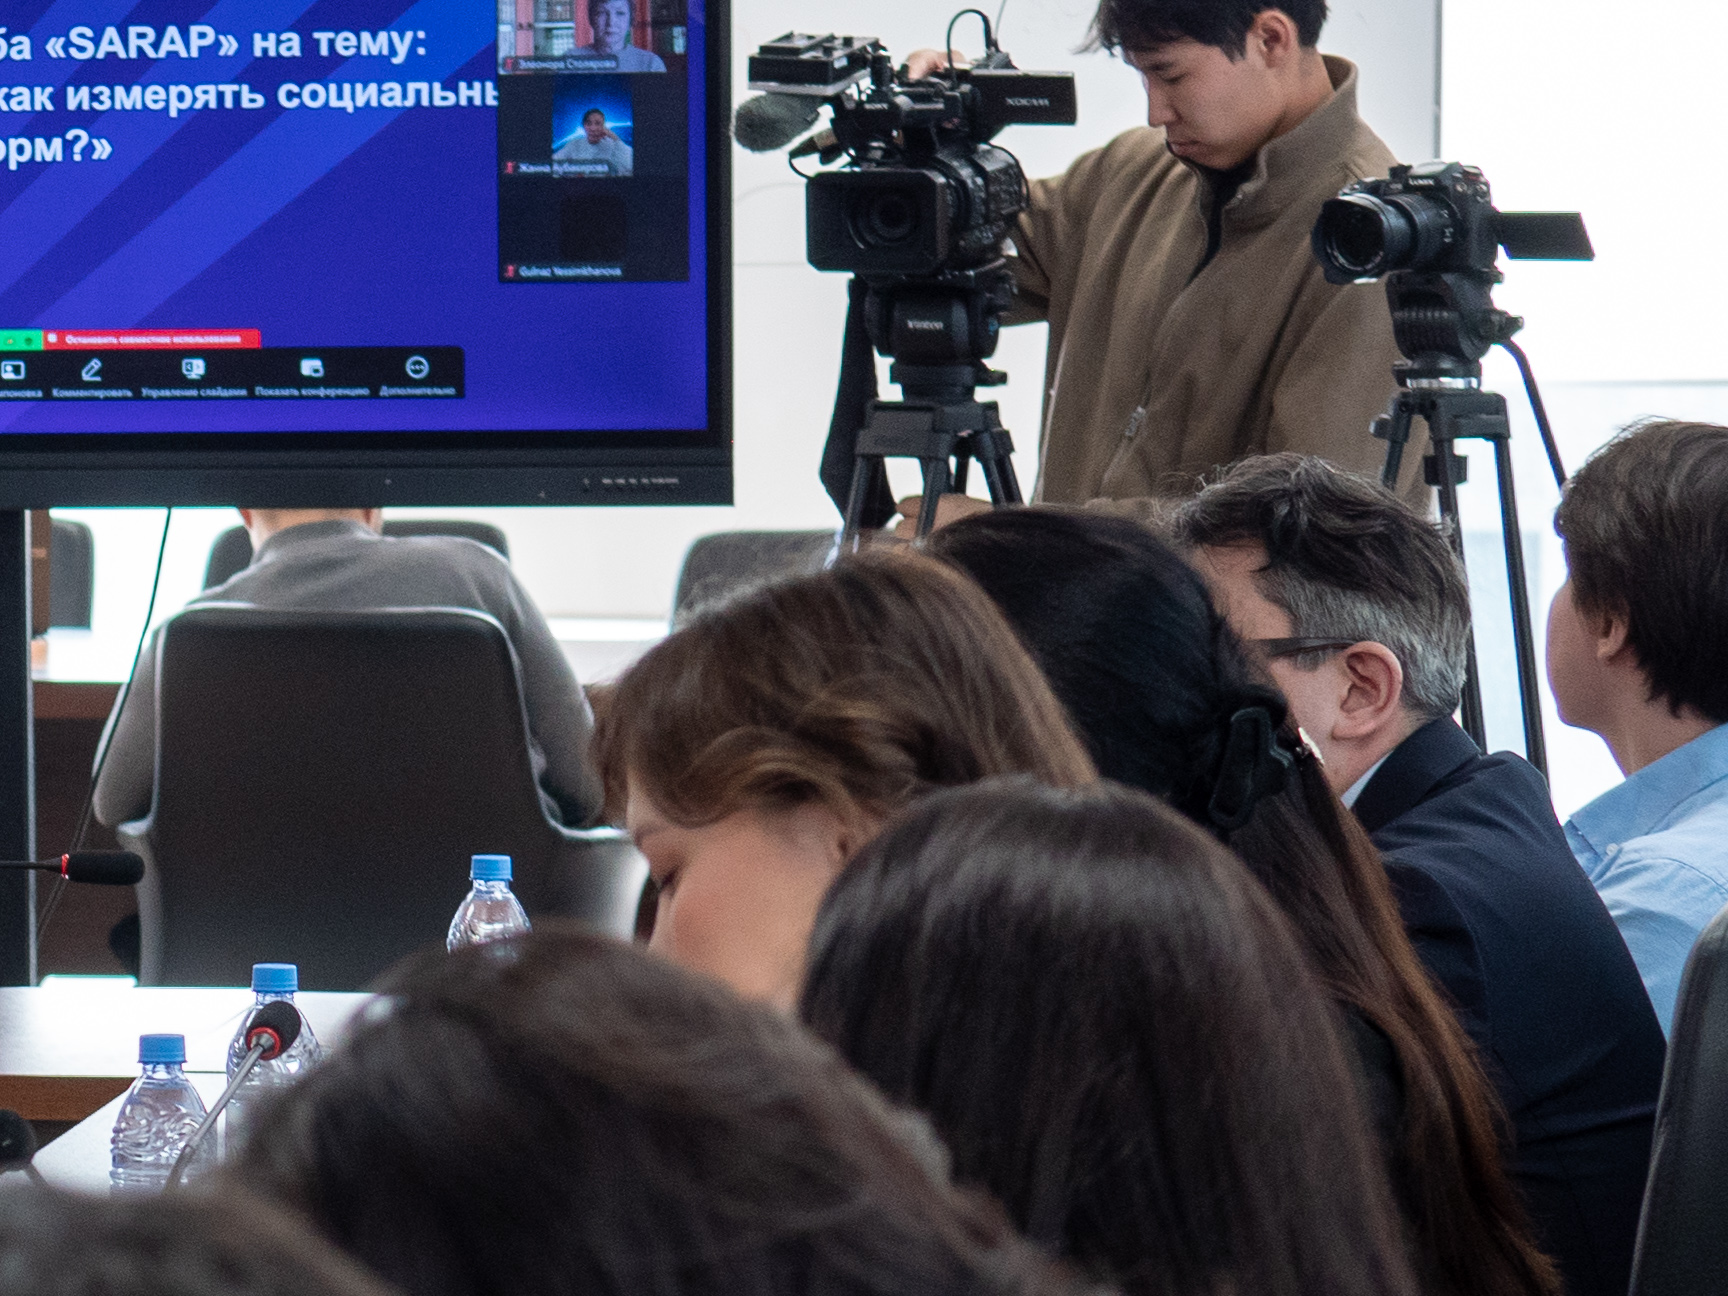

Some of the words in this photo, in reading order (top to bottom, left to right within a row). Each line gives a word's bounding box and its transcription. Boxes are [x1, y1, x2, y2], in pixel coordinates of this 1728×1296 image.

[45, 25, 239, 60] «SARAP»
[252, 32, 302, 58] на
[313, 28, 428, 65] тему:
[66, 82, 265, 117] измерять
